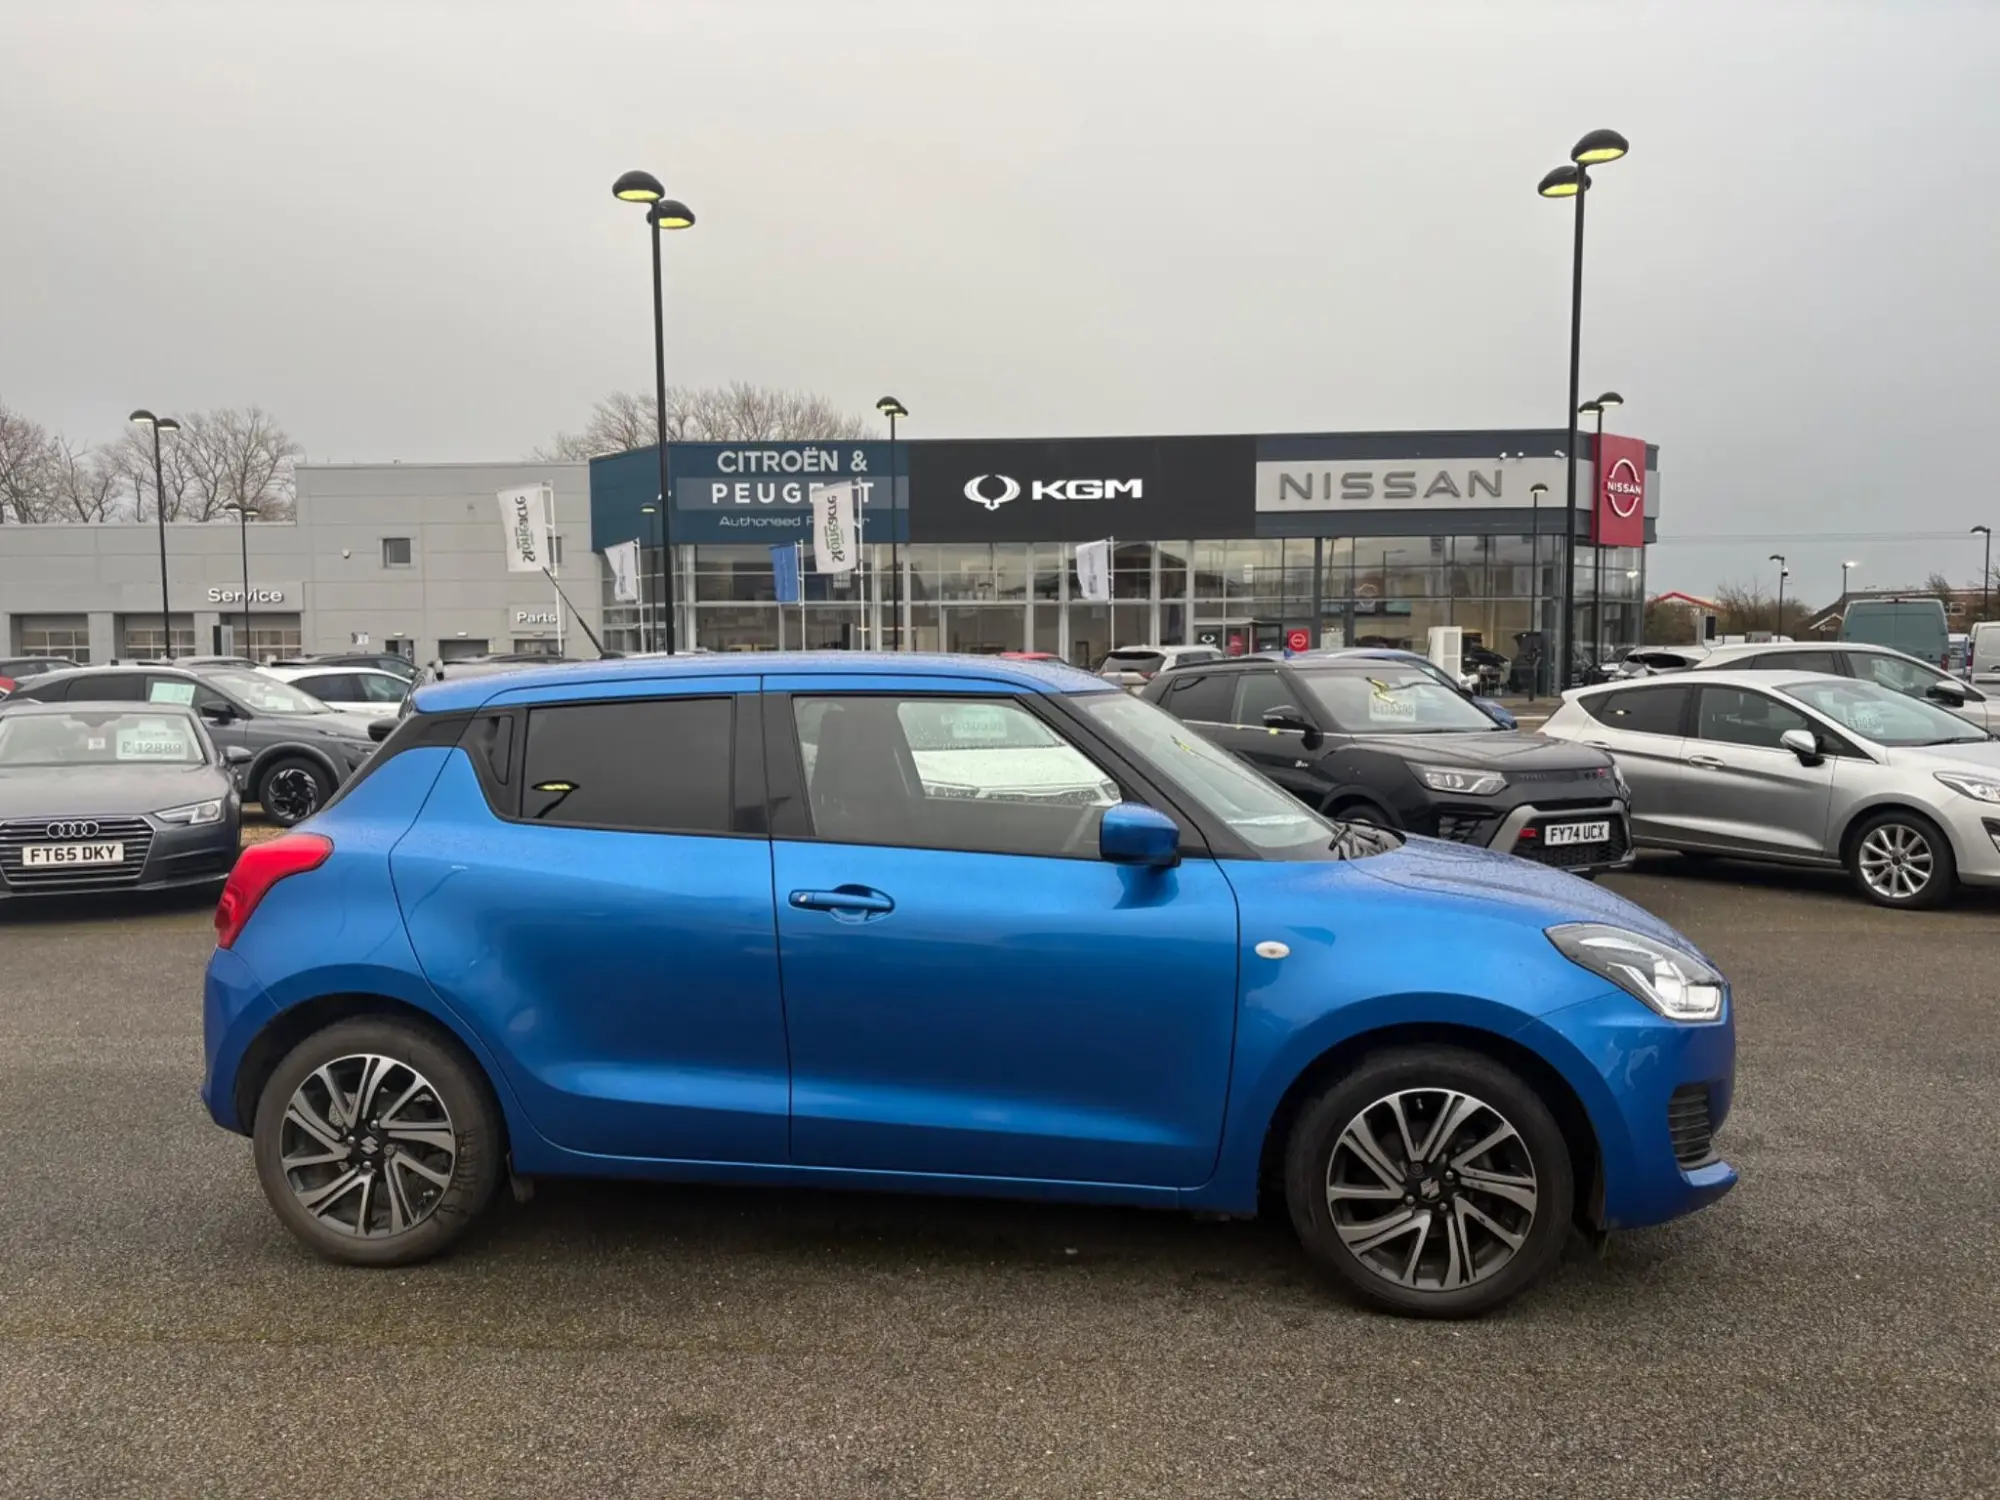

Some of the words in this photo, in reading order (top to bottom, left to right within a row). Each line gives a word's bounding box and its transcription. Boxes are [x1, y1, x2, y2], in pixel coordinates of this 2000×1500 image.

[717, 447, 838, 473] CITROËN
[851, 450, 868, 472] &
[711, 482, 874, 504] PEUGT
[1032, 478, 1143, 501] KGM
[1280, 469, 1502, 500] NISSAN
[1607, 481, 1642, 495] NISSAN
[207, 587, 283, 603] Service
[516, 610, 558, 624] Parts
[1550, 827, 1580, 842] FY74
[1583, 824, 1605, 840] UCX
[30, 847, 77, 863] FT65
[82, 845, 116, 860] DKY
